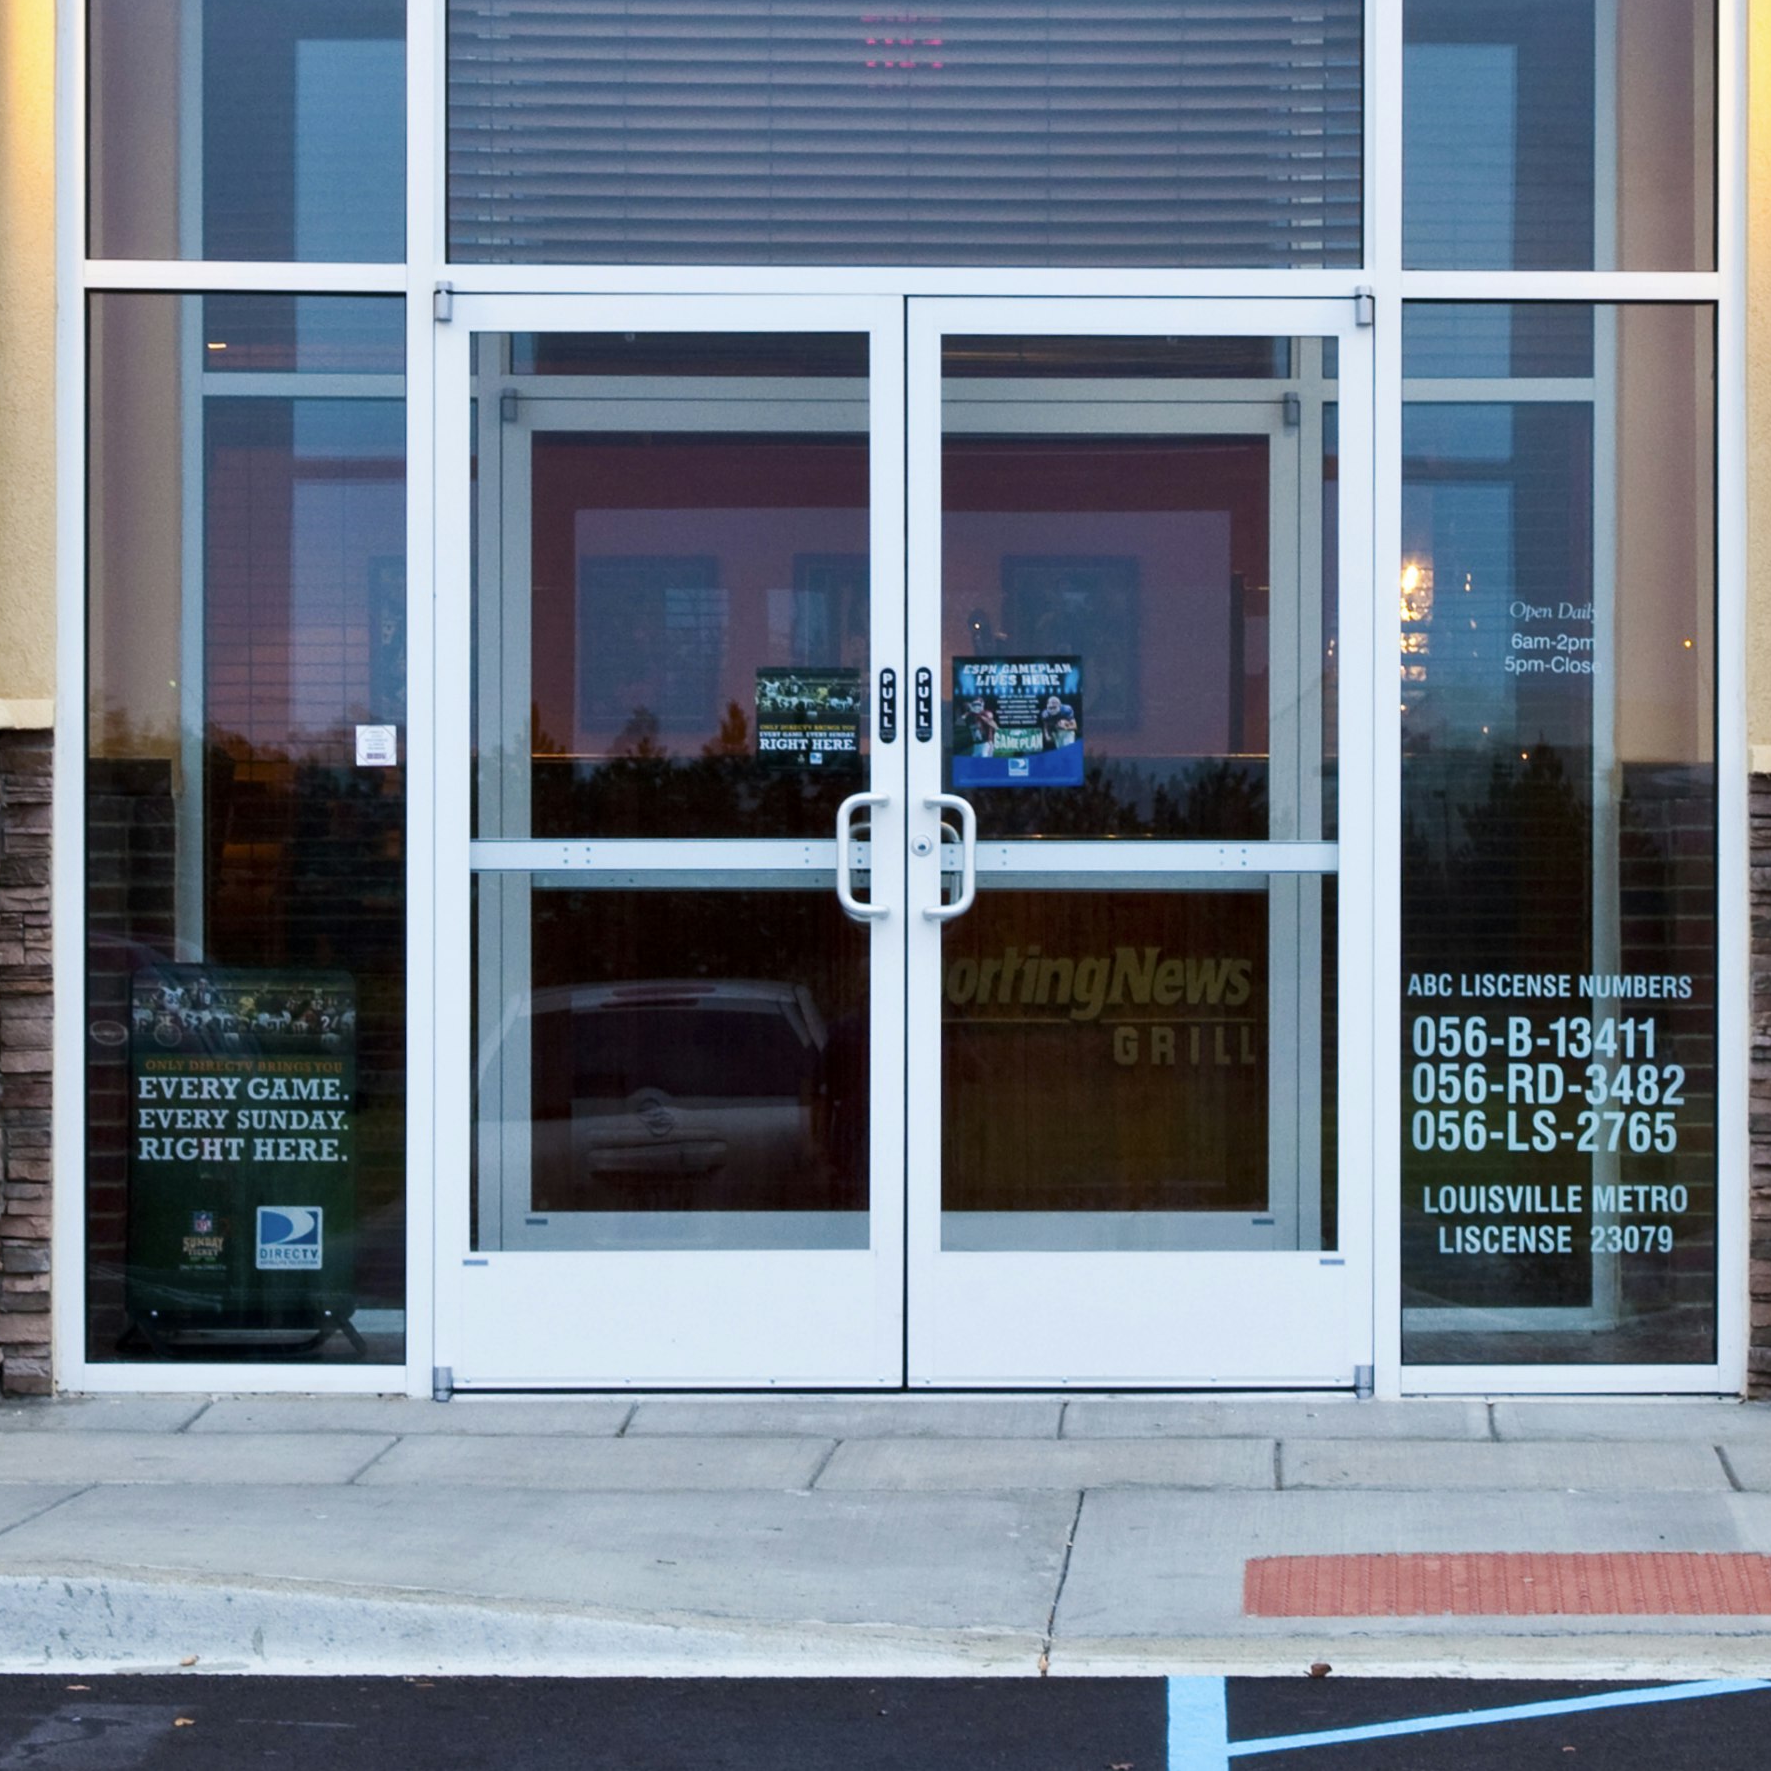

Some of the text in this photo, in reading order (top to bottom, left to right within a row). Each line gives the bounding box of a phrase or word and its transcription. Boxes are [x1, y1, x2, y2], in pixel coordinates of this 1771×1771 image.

[1509, 601, 1599, 624] Open Daily
[1511, 633, 1596, 654] 6am-2pm
[963, 663, 1072, 675] ESPN GAMEPLAN
[1504, 655, 1602, 676] 5pm-Close
[975, 674, 1060, 686] LIVES HERE
[882, 672, 894, 728] PULL
[918, 671, 929, 727] PULL
[759, 738, 857, 750] RIGHT HERE.
[1407, 973, 1693, 999] ABC LISCENSE NUMBERS
[1113, 1026, 1256, 1066] GRILL
[1412, 1016, 1656, 1059] 056-B-13411
[145, 1060, 343, 1073] ONLY DIRECTV BRINGS YOU
[138, 1076, 349, 1101] EVERY GAME.
[1412, 1062, 1686, 1106] 056-RD-3482
[138, 1108, 348, 1131] EVERY SUNDAY.
[1412, 1109, 1678, 1153] 056-LS-2765
[138, 1137, 348, 1162] RIGHT HERE.
[1424, 1185, 1688, 1214] LOUISVILLE METRO
[1439, 1225, 1674, 1254] LISCENSE 23079
[260, 1248, 319, 1259] DIRECTV
